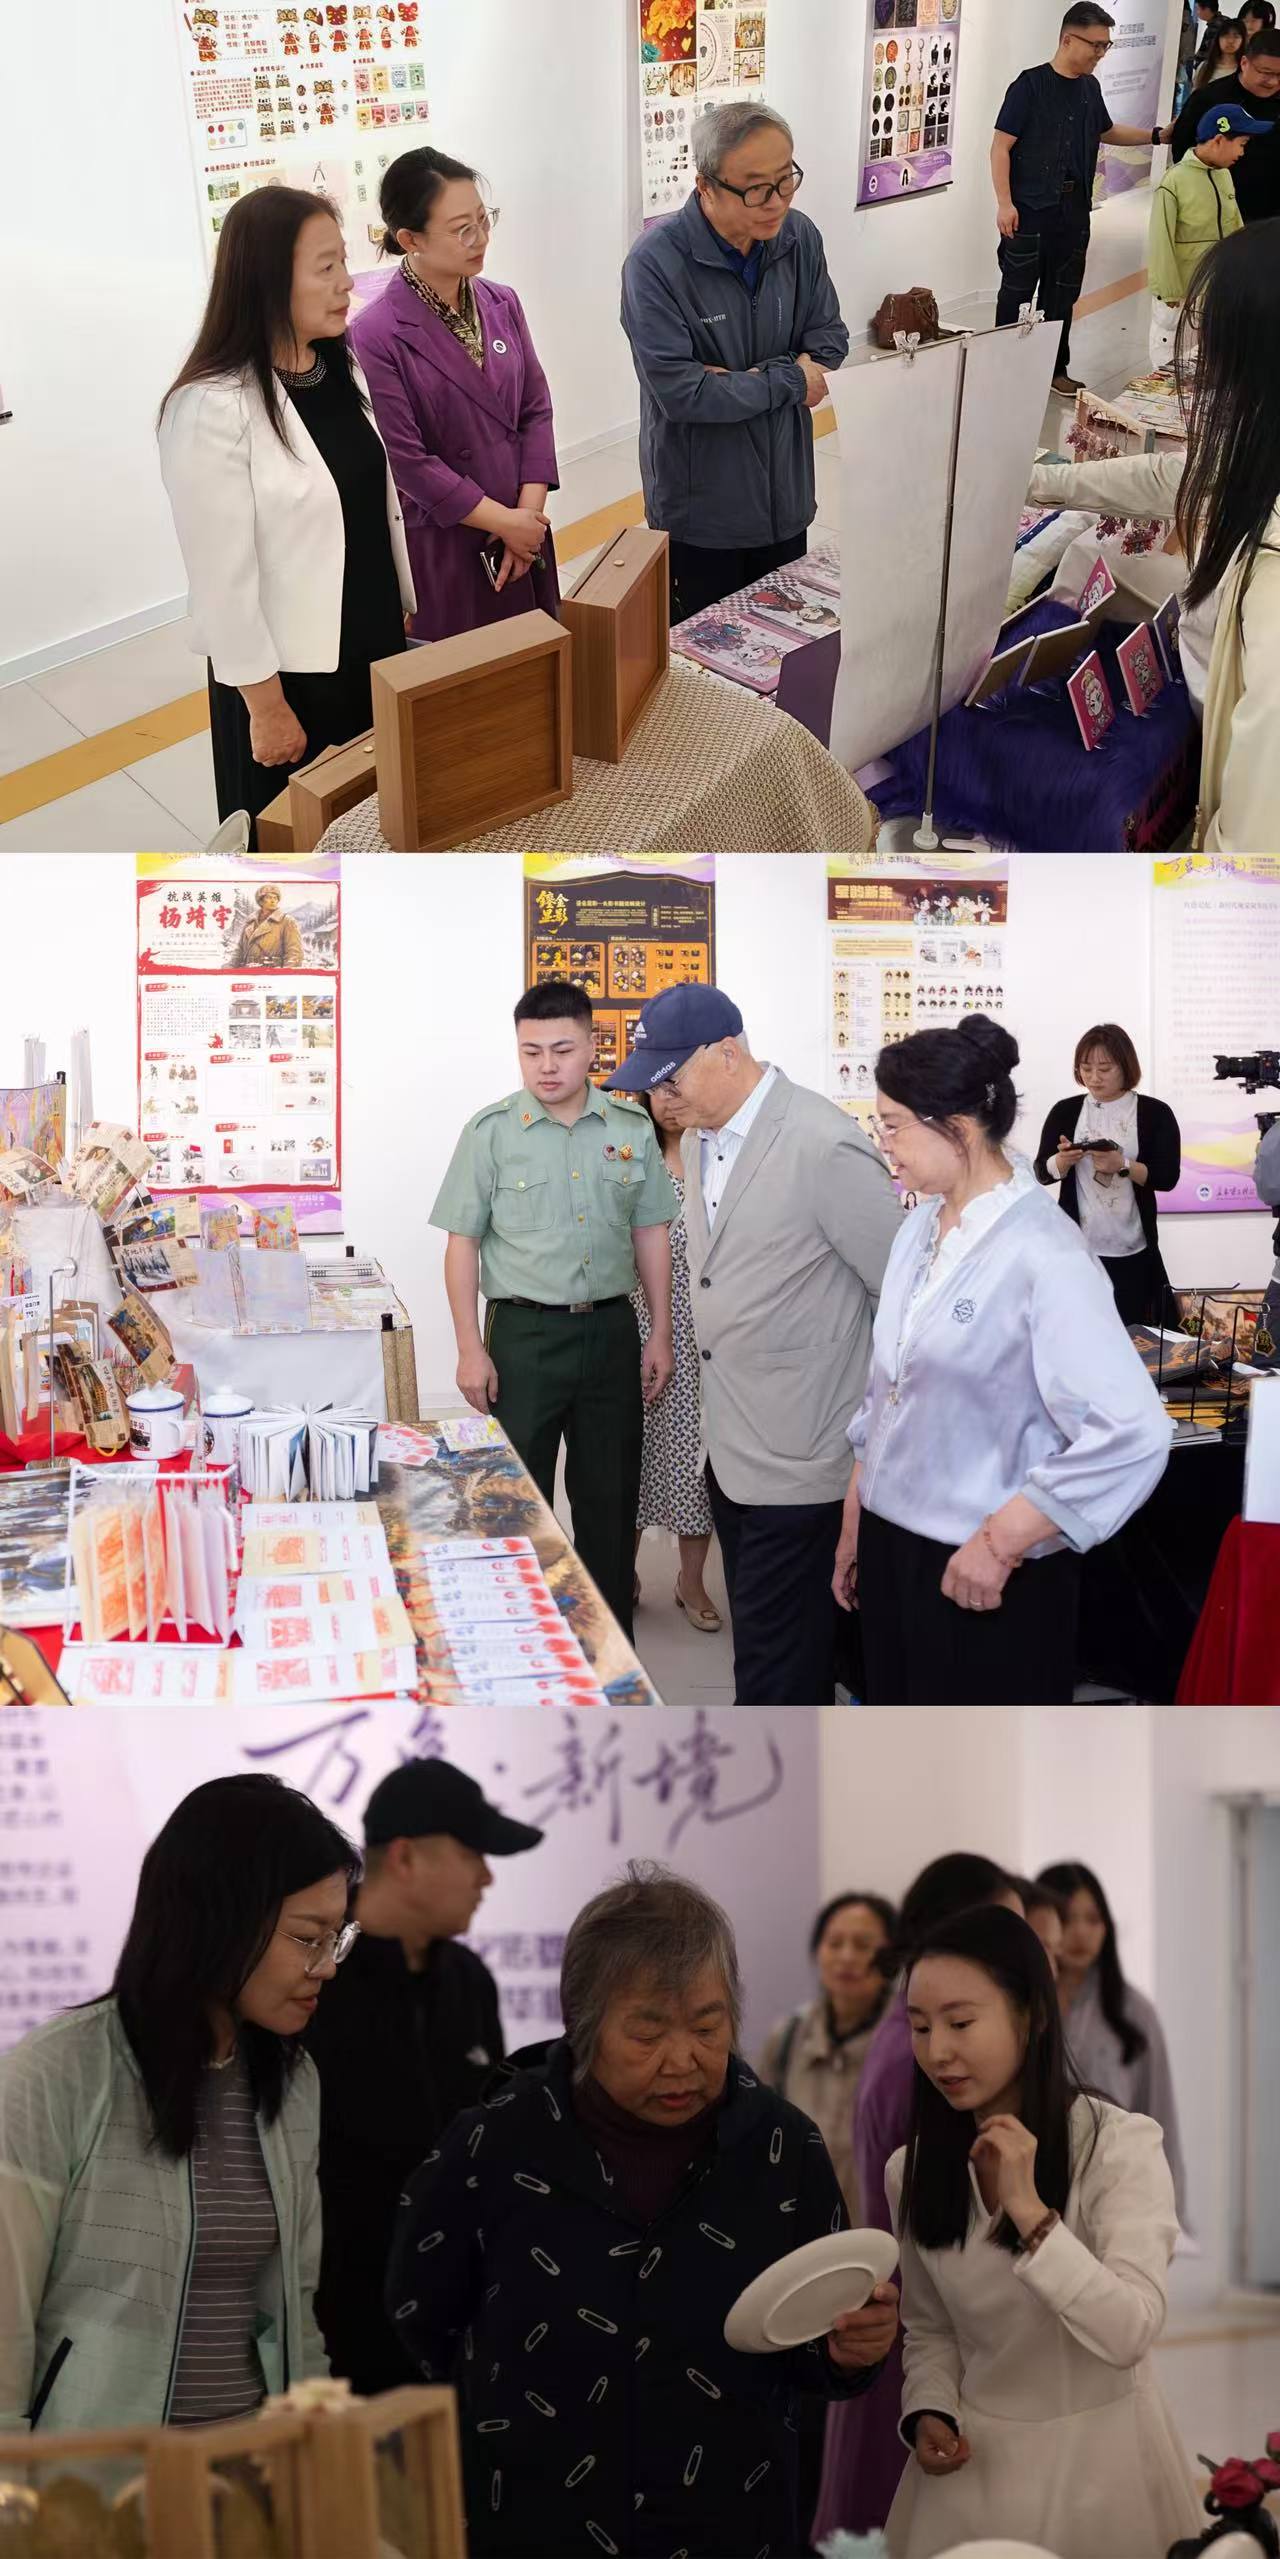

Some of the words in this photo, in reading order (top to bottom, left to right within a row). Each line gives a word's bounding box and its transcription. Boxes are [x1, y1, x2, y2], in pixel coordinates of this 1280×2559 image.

[1217, 116, 1230, 132] 3
[167, 891, 222, 903] 抗战英雄
[159, 905, 232, 930] 杨靖宇
[650, 1060, 677, 1083] adidas
